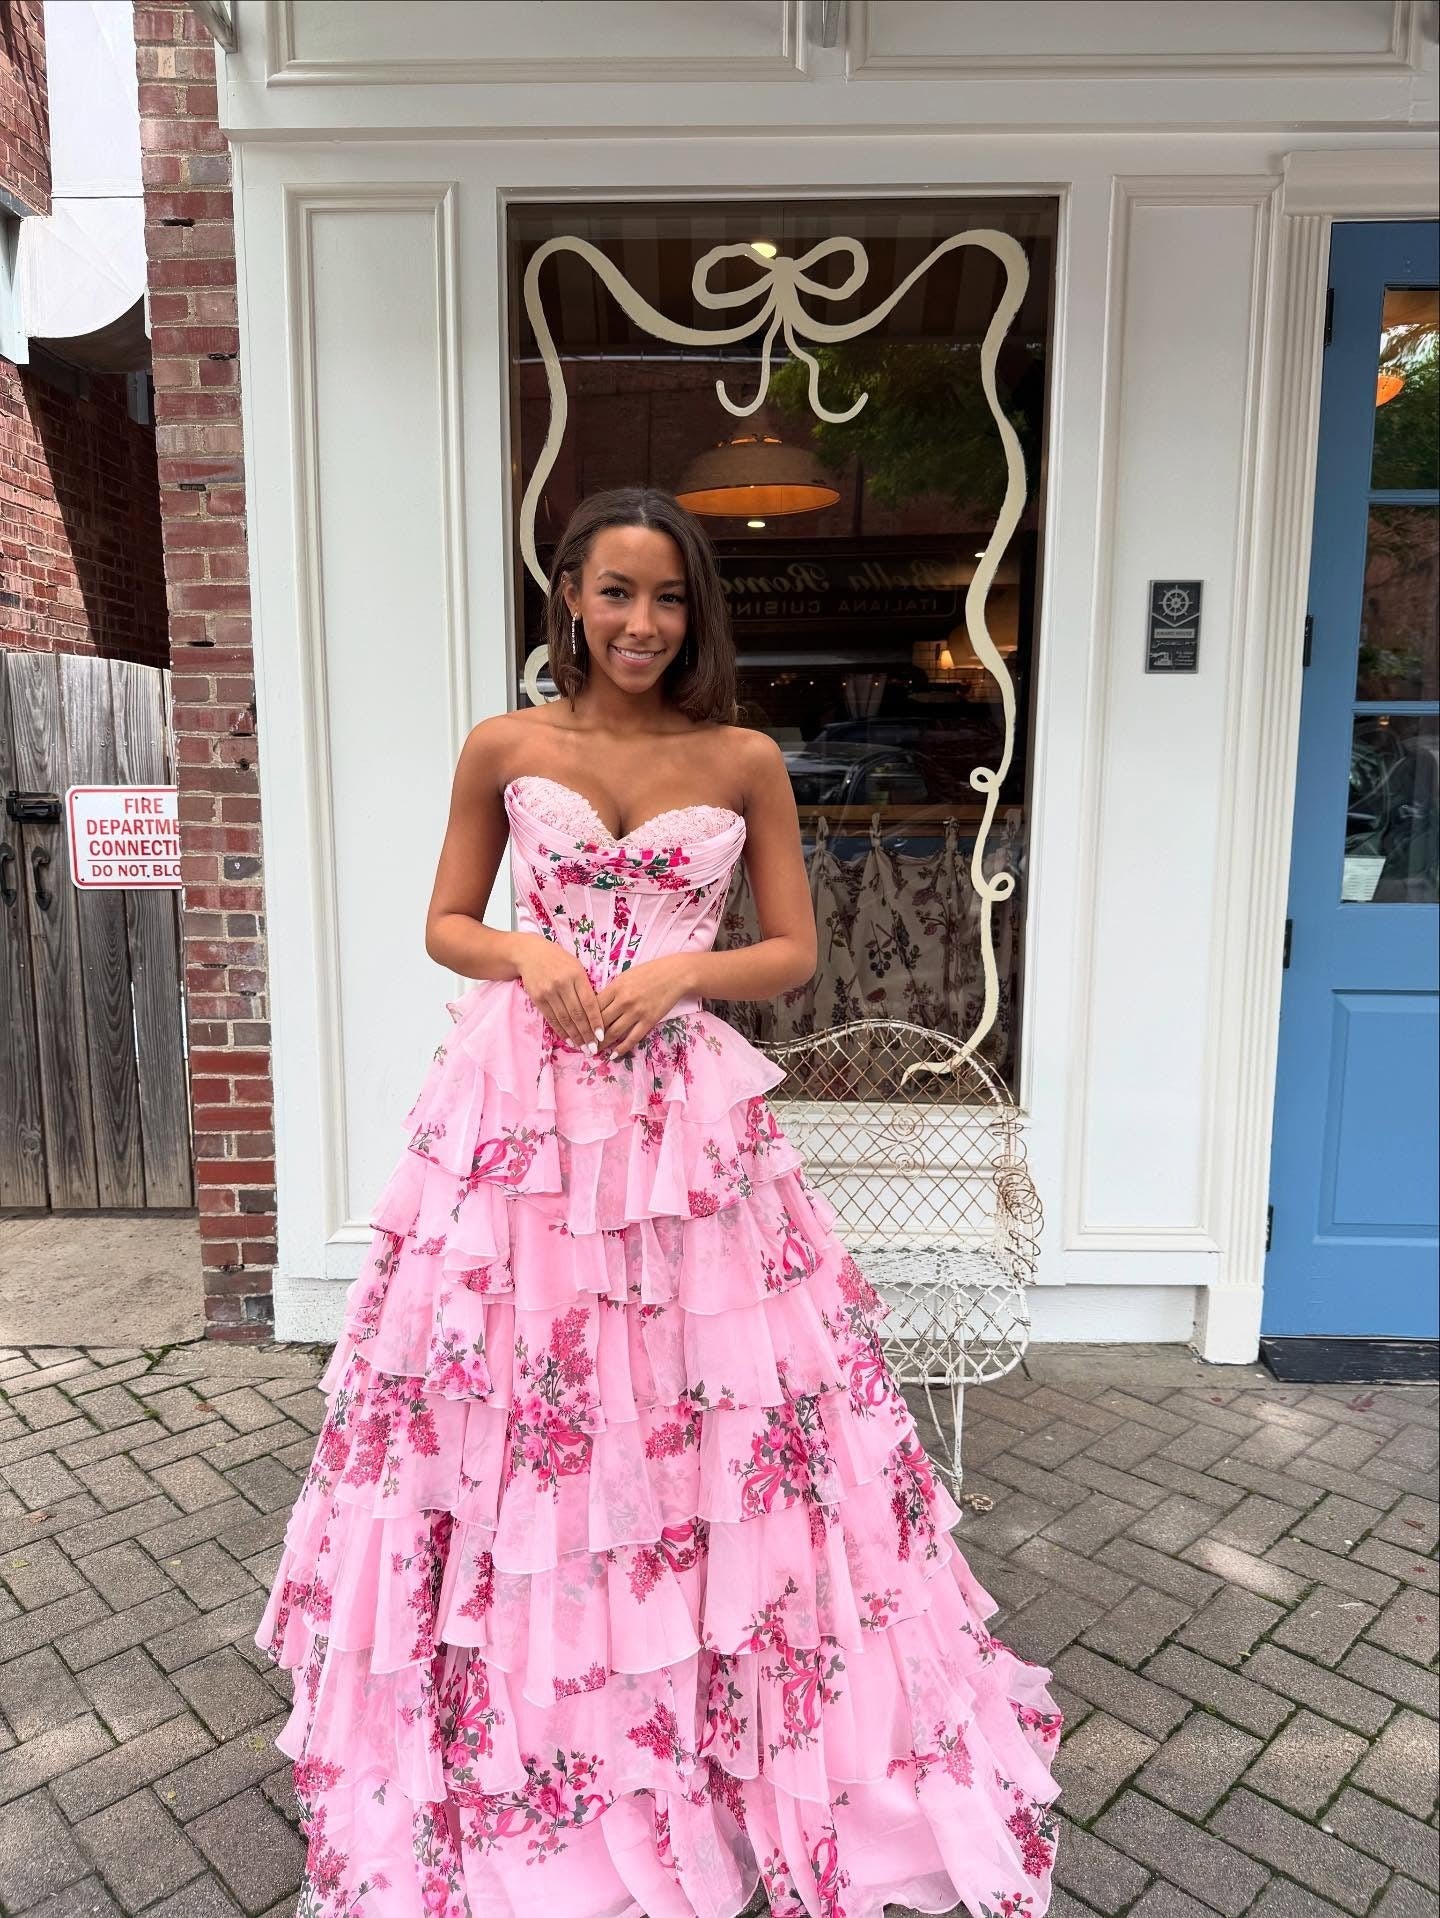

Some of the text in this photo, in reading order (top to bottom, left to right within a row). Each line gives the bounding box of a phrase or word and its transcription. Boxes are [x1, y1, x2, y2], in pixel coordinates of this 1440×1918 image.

[124, 798, 164, 814] FIRE
[86, 819, 180, 835] DEPARTME
[89, 840, 180, 856] CONNECTI
[92, 864, 181, 877] DO NOT BLO
